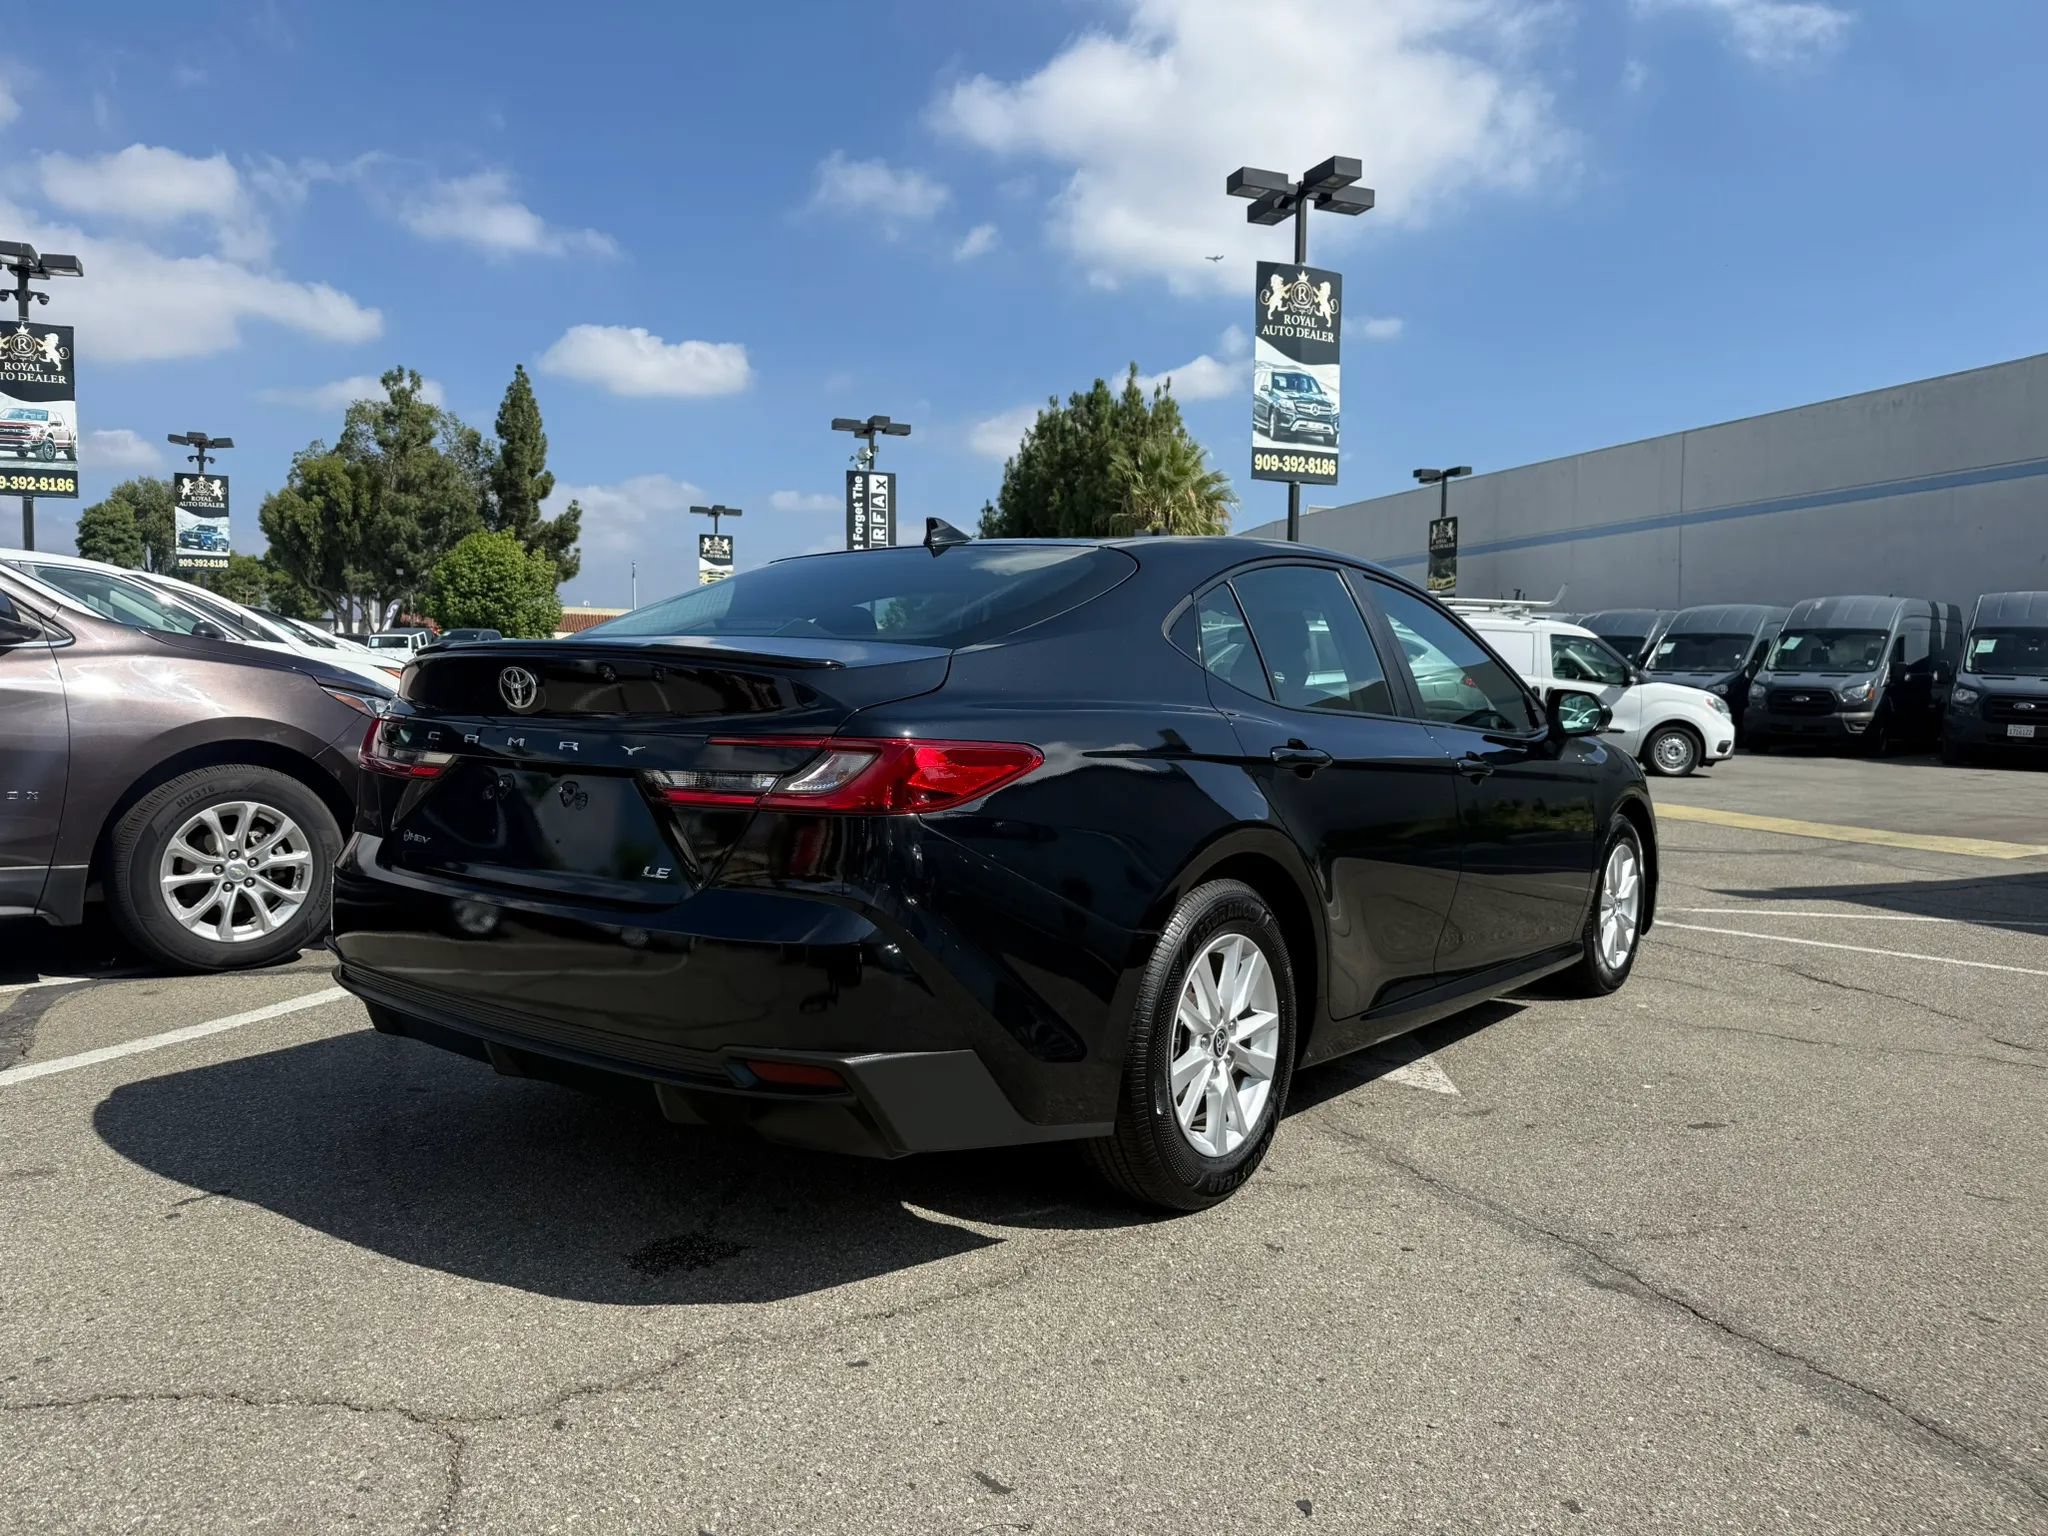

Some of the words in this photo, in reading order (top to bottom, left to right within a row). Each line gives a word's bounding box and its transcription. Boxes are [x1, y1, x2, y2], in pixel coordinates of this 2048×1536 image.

[1284, 314, 1317, 328] ROYAL
[1261, 324, 1294, 337] AUTO
[1296, 327, 1335, 343] DEALER
[4, 361, 43, 372] ROYAL
[18, 372, 68, 384] DEALER
[1254, 453, 1336, 476] 909-392-8186
[852, 475, 864, 499] The
[852, 501, 866, 541] Forget
[428, 732, 646, 756] CAMRY
[641, 865, 672, 879] LE
